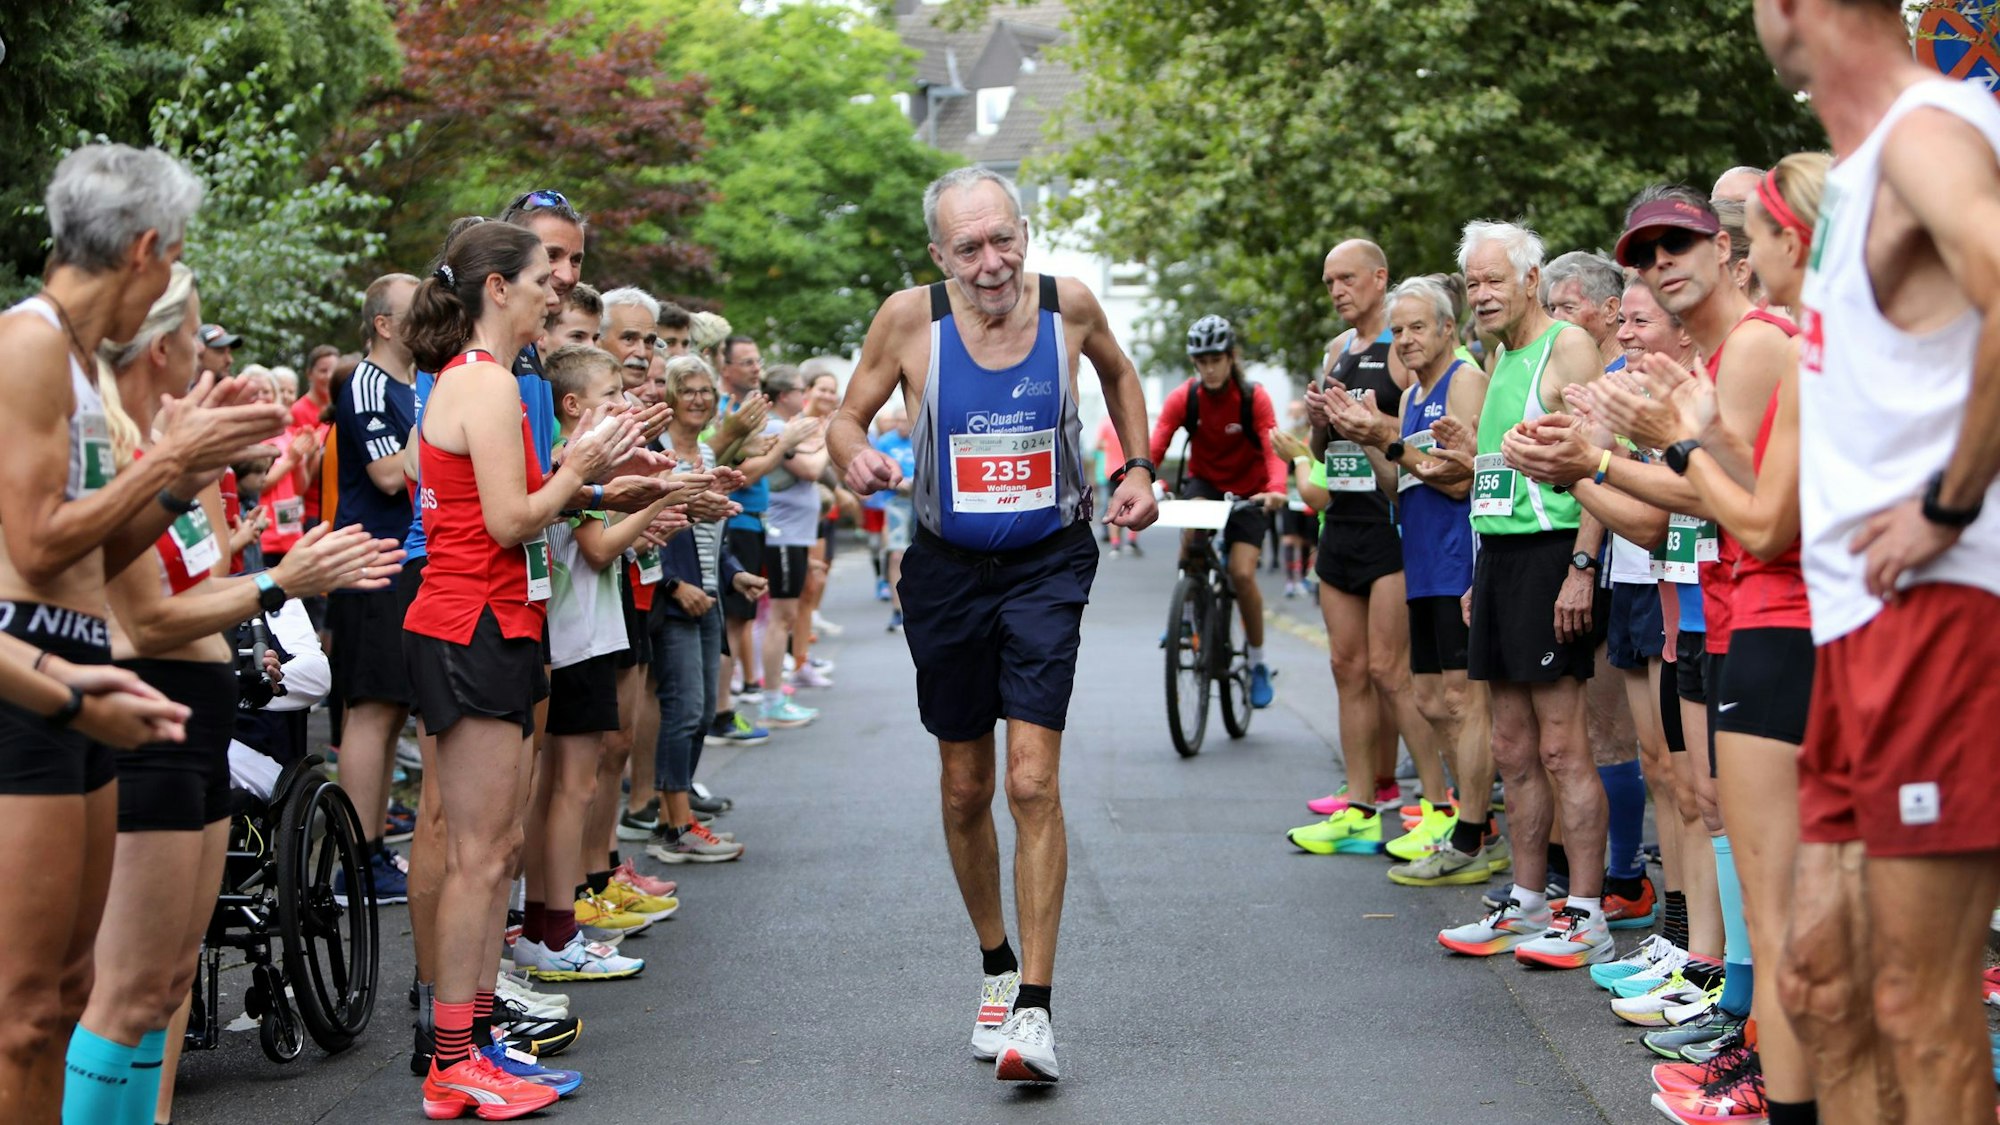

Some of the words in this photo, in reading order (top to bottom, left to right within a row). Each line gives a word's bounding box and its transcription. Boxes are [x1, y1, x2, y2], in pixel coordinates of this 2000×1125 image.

[990, 410, 1024, 426] Quadt
[1012, 438, 1045, 451] 2024
[981, 459, 1031, 482] 235
[1333, 458, 1358, 472] 553
[986, 484, 1027, 493] Wolfgang
[1478, 474, 1500, 492] 556
[997, 496, 1021, 505] HIT
[27, 604, 106, 647] NIKE
